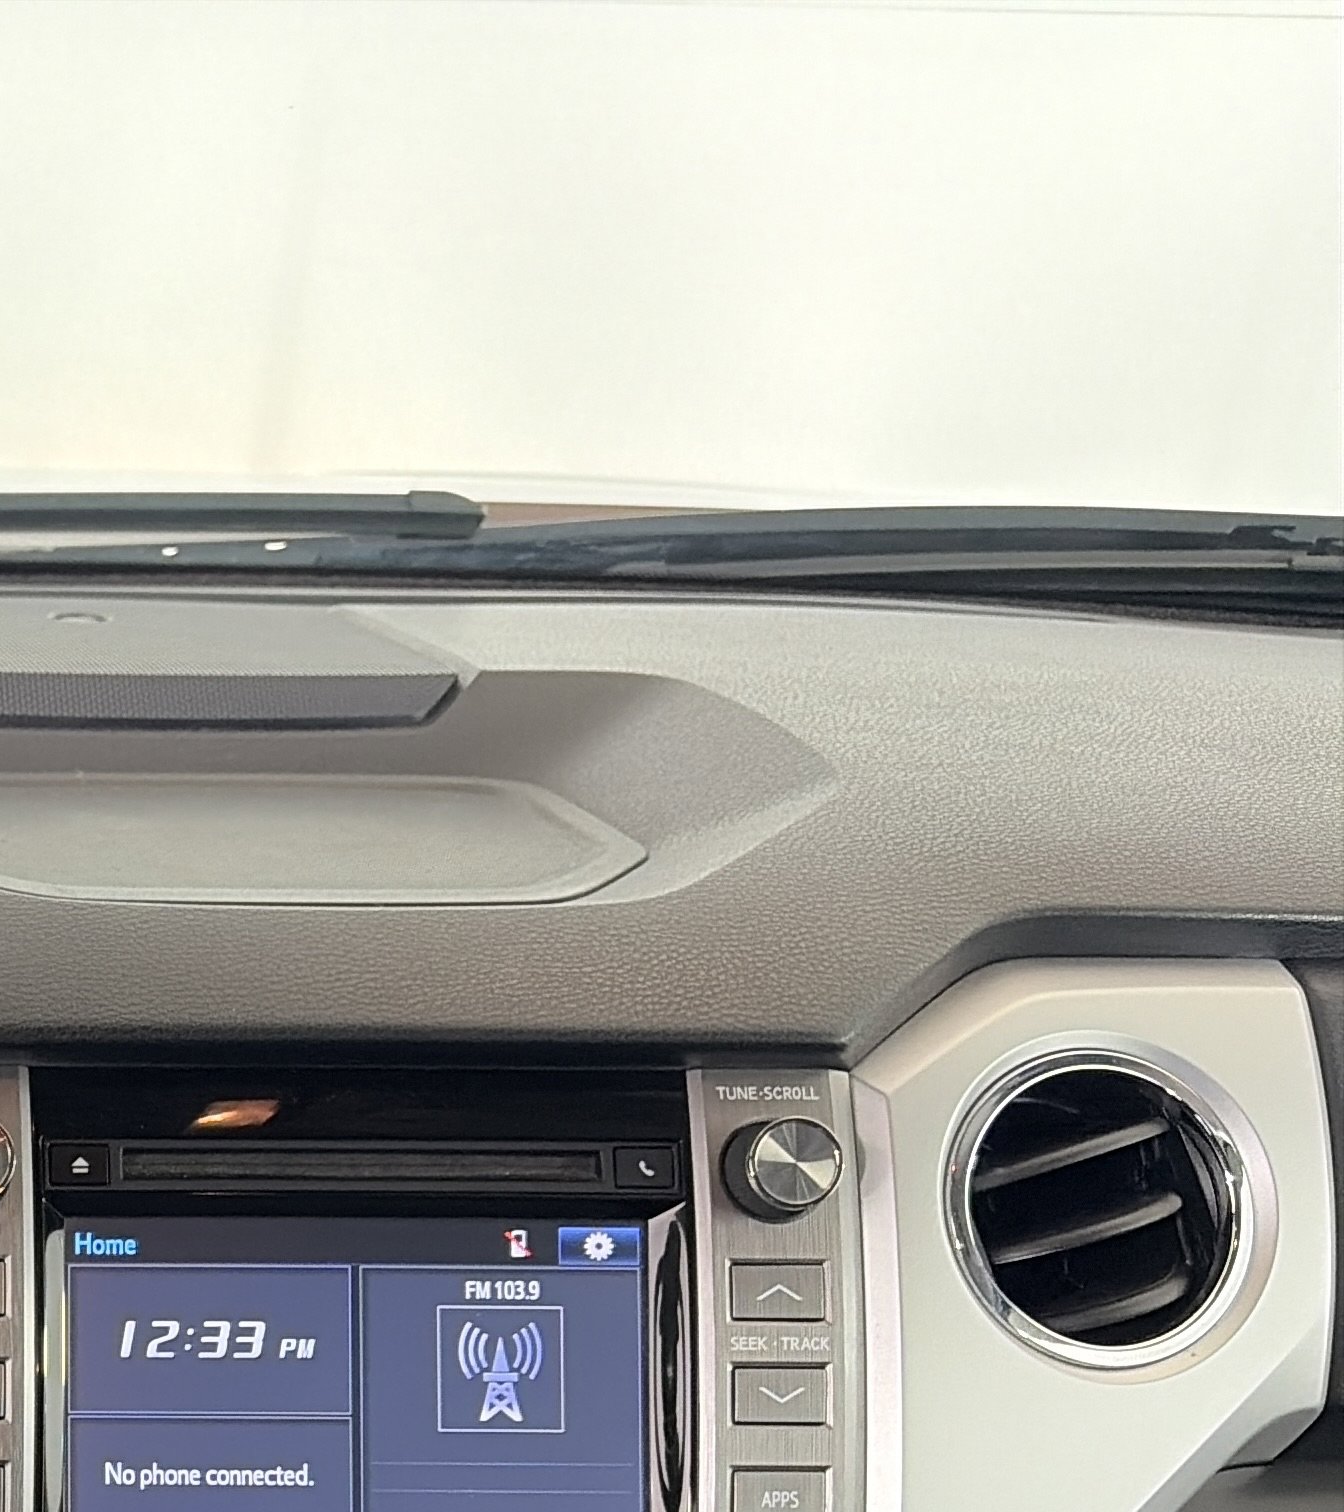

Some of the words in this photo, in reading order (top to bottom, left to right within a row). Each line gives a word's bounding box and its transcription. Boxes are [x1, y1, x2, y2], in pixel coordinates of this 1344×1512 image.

[73, 1232, 138, 1257] Home
[464, 1280, 492, 1299] FM
[493, 1280, 541, 1300] 103.9
[118, 1319, 266, 1360] 12:33
[279, 1338, 316, 1360] PM
[729, 1336, 768, 1352] SEEK
[780, 1336, 830, 1352] TRACK
[103, 1462, 137, 1487] No
[139, 1462, 202, 1490] phone
[204, 1462, 316, 1487] connected.
[761, 1491, 800, 1509] APPS
